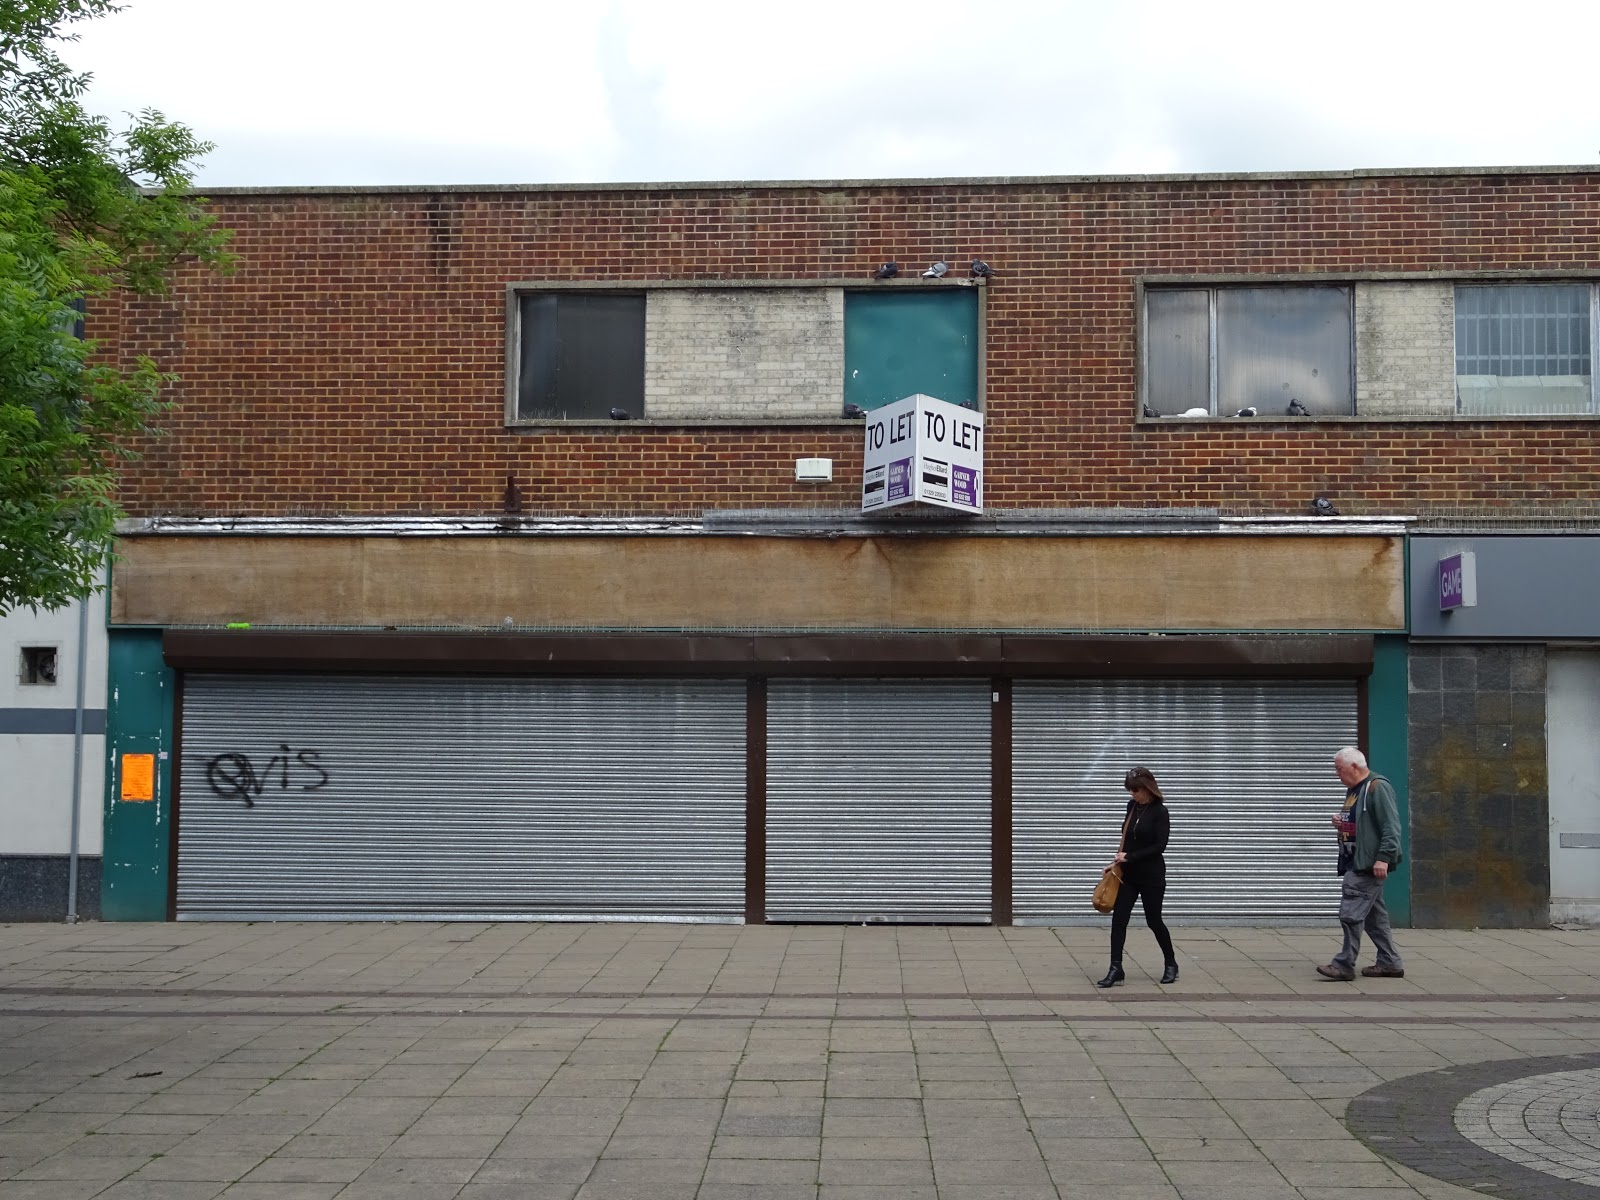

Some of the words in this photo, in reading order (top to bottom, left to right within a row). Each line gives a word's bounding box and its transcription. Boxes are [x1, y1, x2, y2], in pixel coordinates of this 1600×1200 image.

[868, 421, 884, 451] TO
[890, 410, 915, 445] LET
[924, 410, 946, 442] TO
[953, 419, 981, 452] LET
[1441, 567, 1461, 598] GAME
